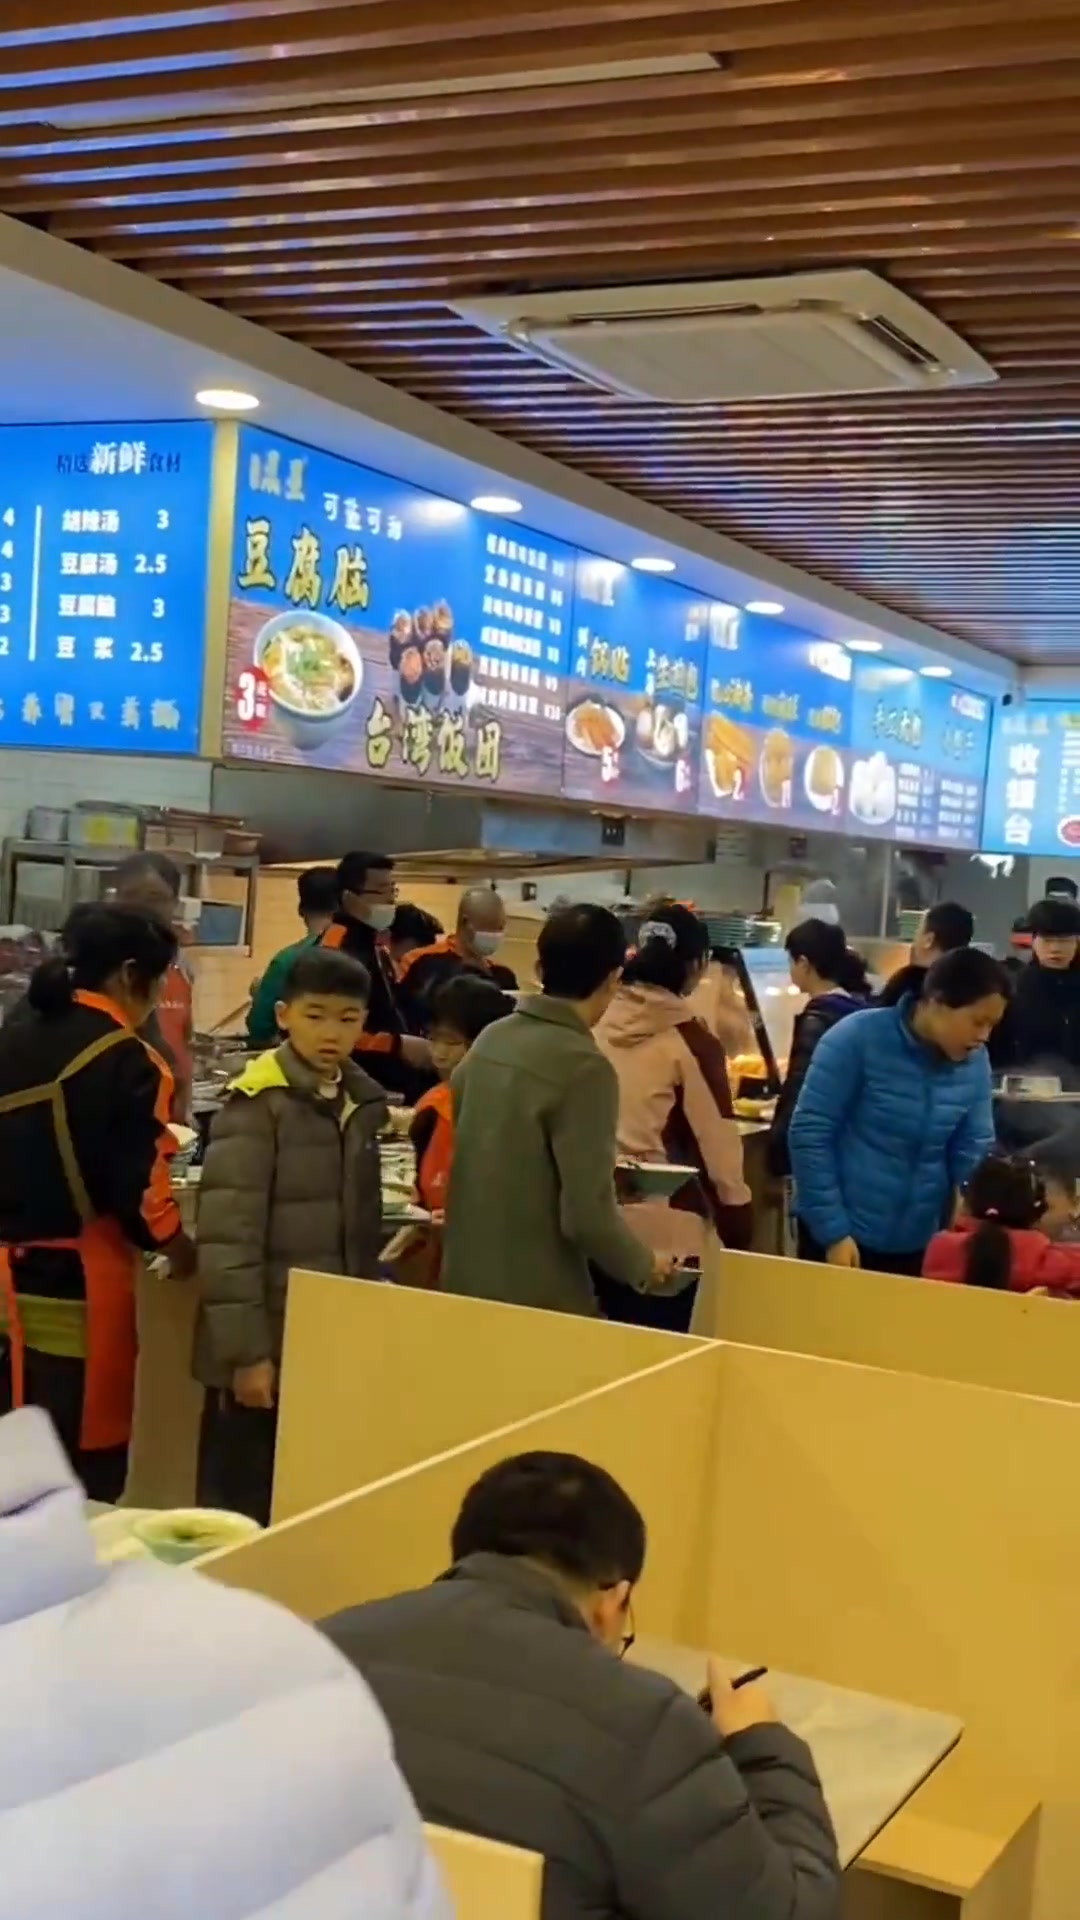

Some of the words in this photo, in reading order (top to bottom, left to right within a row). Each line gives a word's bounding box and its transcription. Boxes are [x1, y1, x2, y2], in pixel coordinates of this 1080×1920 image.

[2, 507, 15, 527] 4
[62, 509, 119, 533] 胡辣汤
[156, 509, 169, 530] 3
[0, 540, 14, 559] 4
[60, 552, 118, 576] 豆腐汤
[134, 554, 167, 574] 2.5
[237, 515, 370, 614] 豆腐脑
[0, 572, 12, 592] 3
[152, 598, 165, 618] 3
[130, 642, 163, 662] 2.5
[238, 672, 256, 721] 3
[365, 697, 501, 783] 台湾饭团
